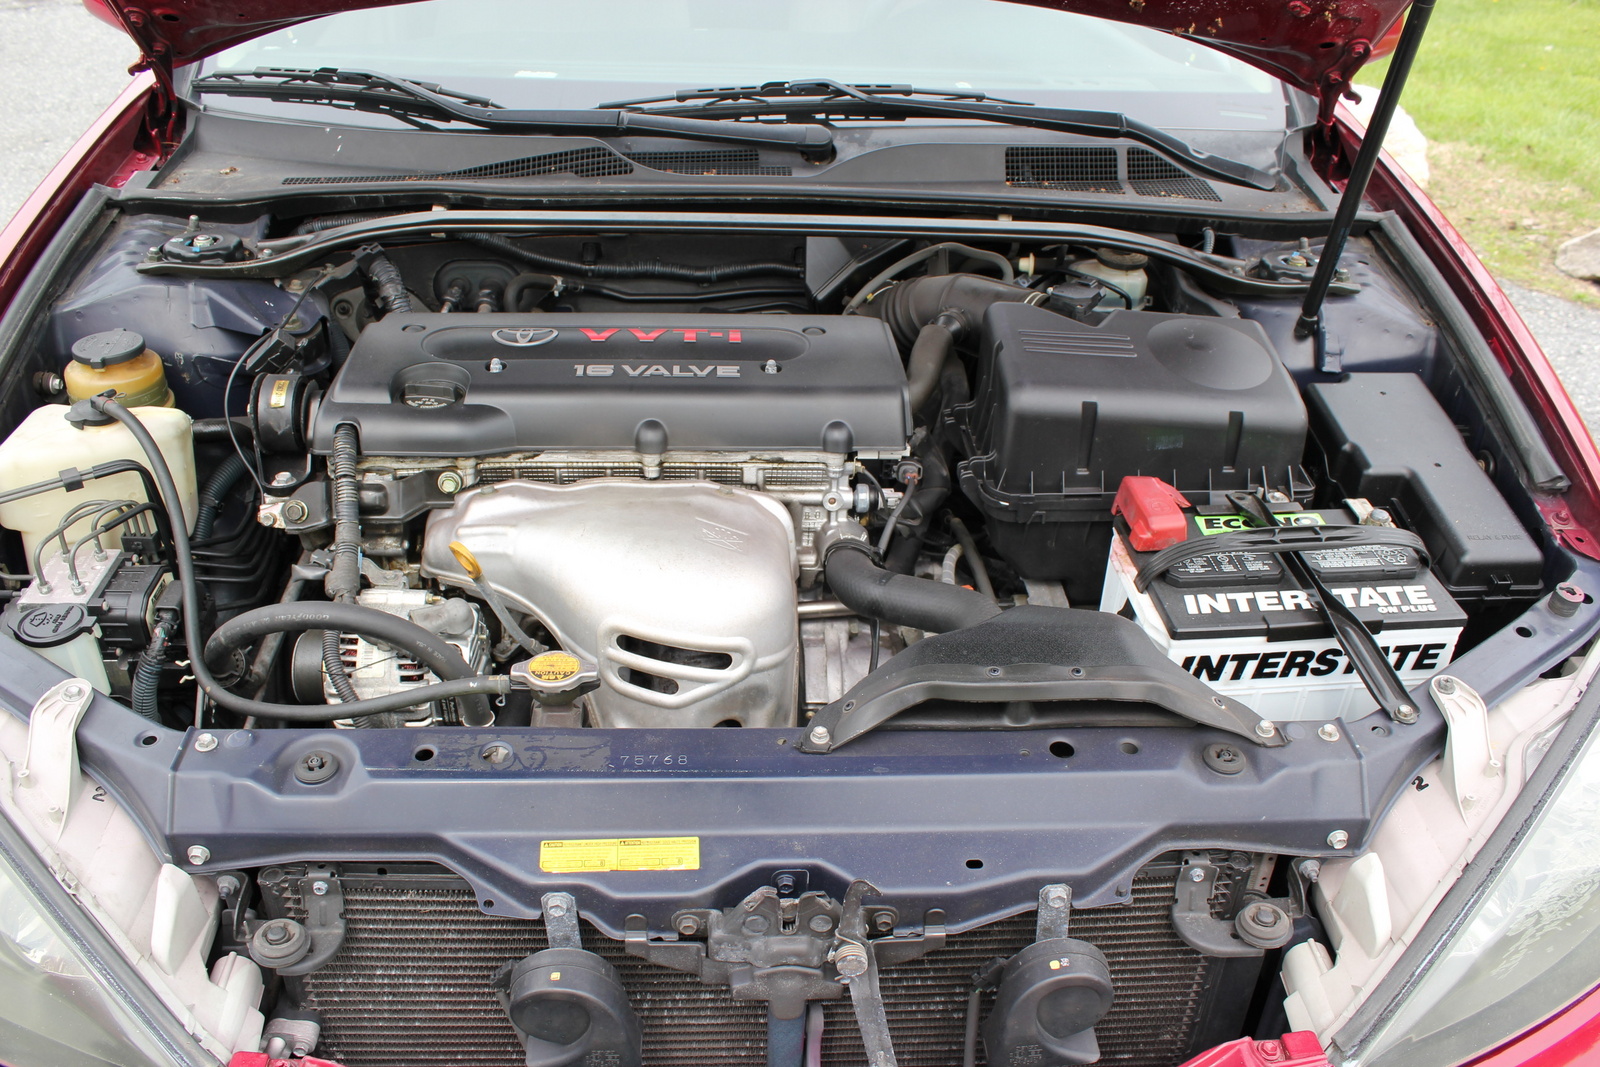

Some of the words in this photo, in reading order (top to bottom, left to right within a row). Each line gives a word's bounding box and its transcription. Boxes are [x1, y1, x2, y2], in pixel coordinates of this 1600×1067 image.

[574, 364, 615, 377] 16
[621, 364, 741, 378] VALVE
[1183, 585, 1435, 615] INTERTATE
[1400, 604, 1438, 613] PLUS
[1181, 643, 1448, 682] INTERSTE
[620, 755, 688, 766] 75768
[1411, 775, 1430, 792] 2
[92, 786, 107, 802] 2
